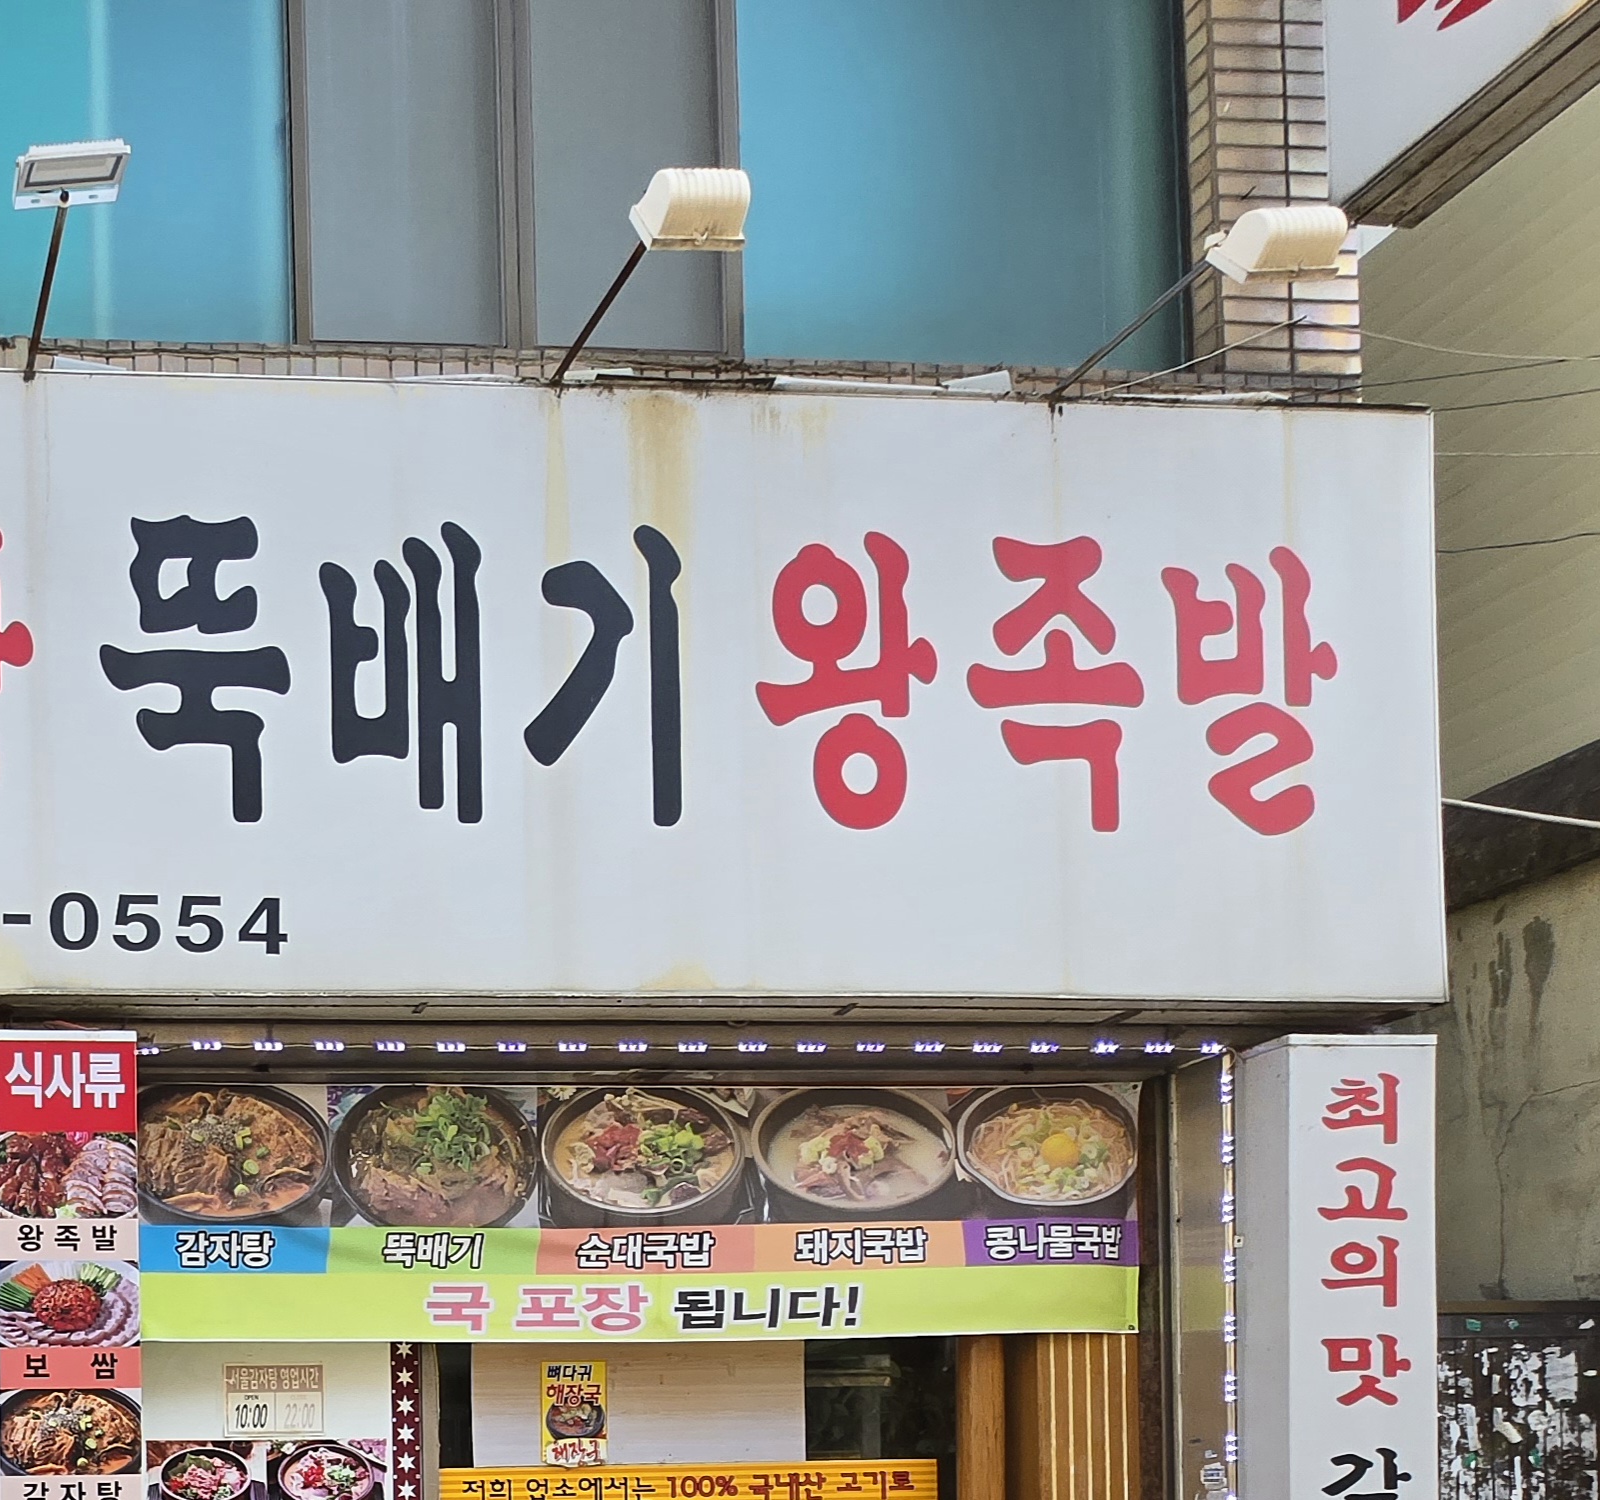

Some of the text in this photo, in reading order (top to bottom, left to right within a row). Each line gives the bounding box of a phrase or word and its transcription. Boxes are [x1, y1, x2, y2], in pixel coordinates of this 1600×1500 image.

[100, 514, 684, 827] 뚝배기
[755, 530, 1338, 838] 왕족발
[4, 1051, 126, 1108] 식사류
[1317, 1072, 1408, 1307] 최고의
[17, 1224, 118, 1253] 왕족발
[176, 1224, 1122, 1269] 감자탕 뚝배기 순대국밥 돼지국밥 콩나물국밥
[425, 1284, 861, 1332] 국 포장 됩니다!
[280, 1367, 319, 1389] 영업시간
[547, 1365, 592, 1381] 뼈다귀
[1320, 1334, 1412, 1406] 맛
[546, 1384, 602, 1405] 해장국
[235, 1402, 316, 1429] 10:00 22:00
[666, 1475, 739, 1498] 100%
[837, 1470, 915, 1500] 고기로
